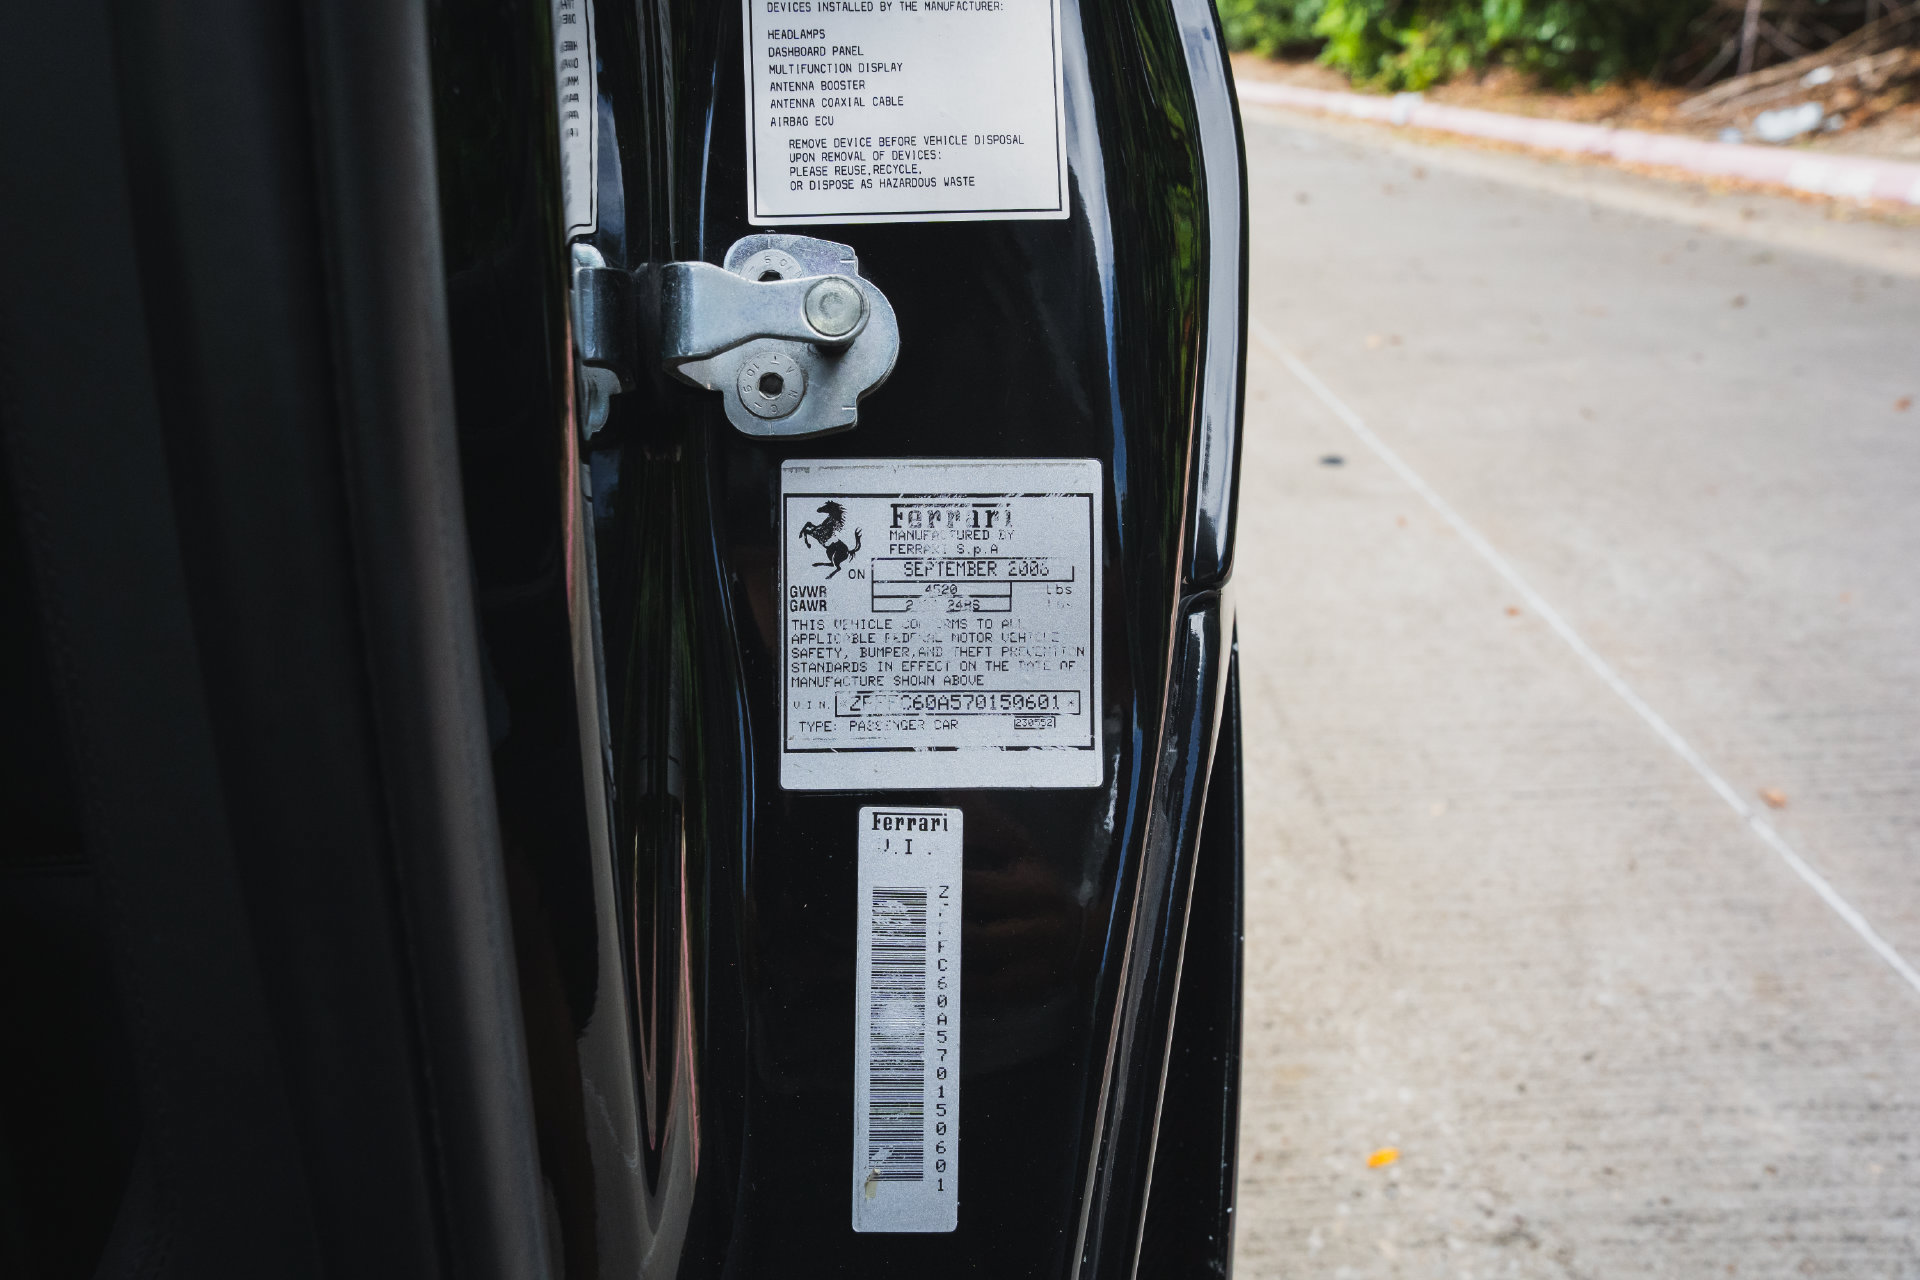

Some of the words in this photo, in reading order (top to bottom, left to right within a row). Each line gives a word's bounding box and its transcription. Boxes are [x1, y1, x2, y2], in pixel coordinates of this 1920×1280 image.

[767, 2, 812, 13] DEVICES
[818, 2, 873, 12] INSTALLED
[880, 2, 892, 11] BY
[901, 2, 917, 11] THE
[925, 1, 1003, 11] MANUFACTURER:
[768, 29, 826, 40] HEADLAMPS
[768, 46, 826, 58] DASHBOARD
[832, 46, 864, 56] PANEL
[769, 63, 852, 75] MULTIFUNCTION
[858, 62, 903, 73] DISPLAY
[770, 80, 814, 92] ANTENNA
[821, 80, 865, 90] BOOSTER
[771, 97, 815, 108] ANTENNA
[822, 97, 864, 108] COAXIAL
[873, 96, 903, 107] CABLE
[771, 116, 809, 127] AIRBAG
[815, 116, 834, 126] ECU
[789, 138, 827, 149] REMOVE
[833, 137, 871, 148] DEVICE
[879, 136, 916, 146] BEFORE
[924, 135, 968, 145] VEHICLE
[974, 135, 1024, 145] DISPOSAL
[789, 152, 815, 163] UPON
[821, 151, 865, 161] REMOVAL
[873, 150, 885, 160] OF
[892, 150, 942, 160] DEVICES:
[789, 166, 828, 177] PLEASE
[790, 180, 803, 191] OR
[810, 179, 854, 190] DISPOSE
[861, 179, 872, 189] AS
[879, 177, 937, 188] HAZARDOUS
[944, 176, 975, 187] WASTE
[890, 503, 1013, 528] Ferrari
[957, 543, 999, 557] S.p.A
[848, 569, 865, 579] ON
[904, 561, 997, 577] SEPTEMBER
[790, 585, 826, 598] GVWR
[790, 600, 827, 612] GAWR
[792, 619, 825, 630] THIS
[834, 619, 892, 630] VEHICLE
[977, 619, 993, 629] TO
[792, 633, 876, 645] APPLICBLE
[885, 632, 943, 644] FEDEAL
[951, 633, 993, 643] MOTOR
[1002, 632, 1060, 643] VEHCLE
[792, 647, 849, 659] SAFETY,
[954, 647, 993, 657] THEFT
[1002, 646, 1085, 657] PREVENTIN
[792, 662, 868, 673] STANDARDS
[877, 661, 893, 671] IN
[901, 661, 950, 672] EFFECT
[960, 661, 976, 671] ON
[987, 661, 1009, 671] THE
[1060, 661, 1075, 670] OF
[792, 675, 884, 687] MANUFACTURE
[893, 675, 935, 686] SHOWN
[944, 675, 984, 686] ABOVE
[799, 721, 837, 732] TYPE:
[935, 720, 958, 730] CAR
[871, 812, 948, 832] Ferrari
[934, 886, 950, 1192] ZFC60A570150601
